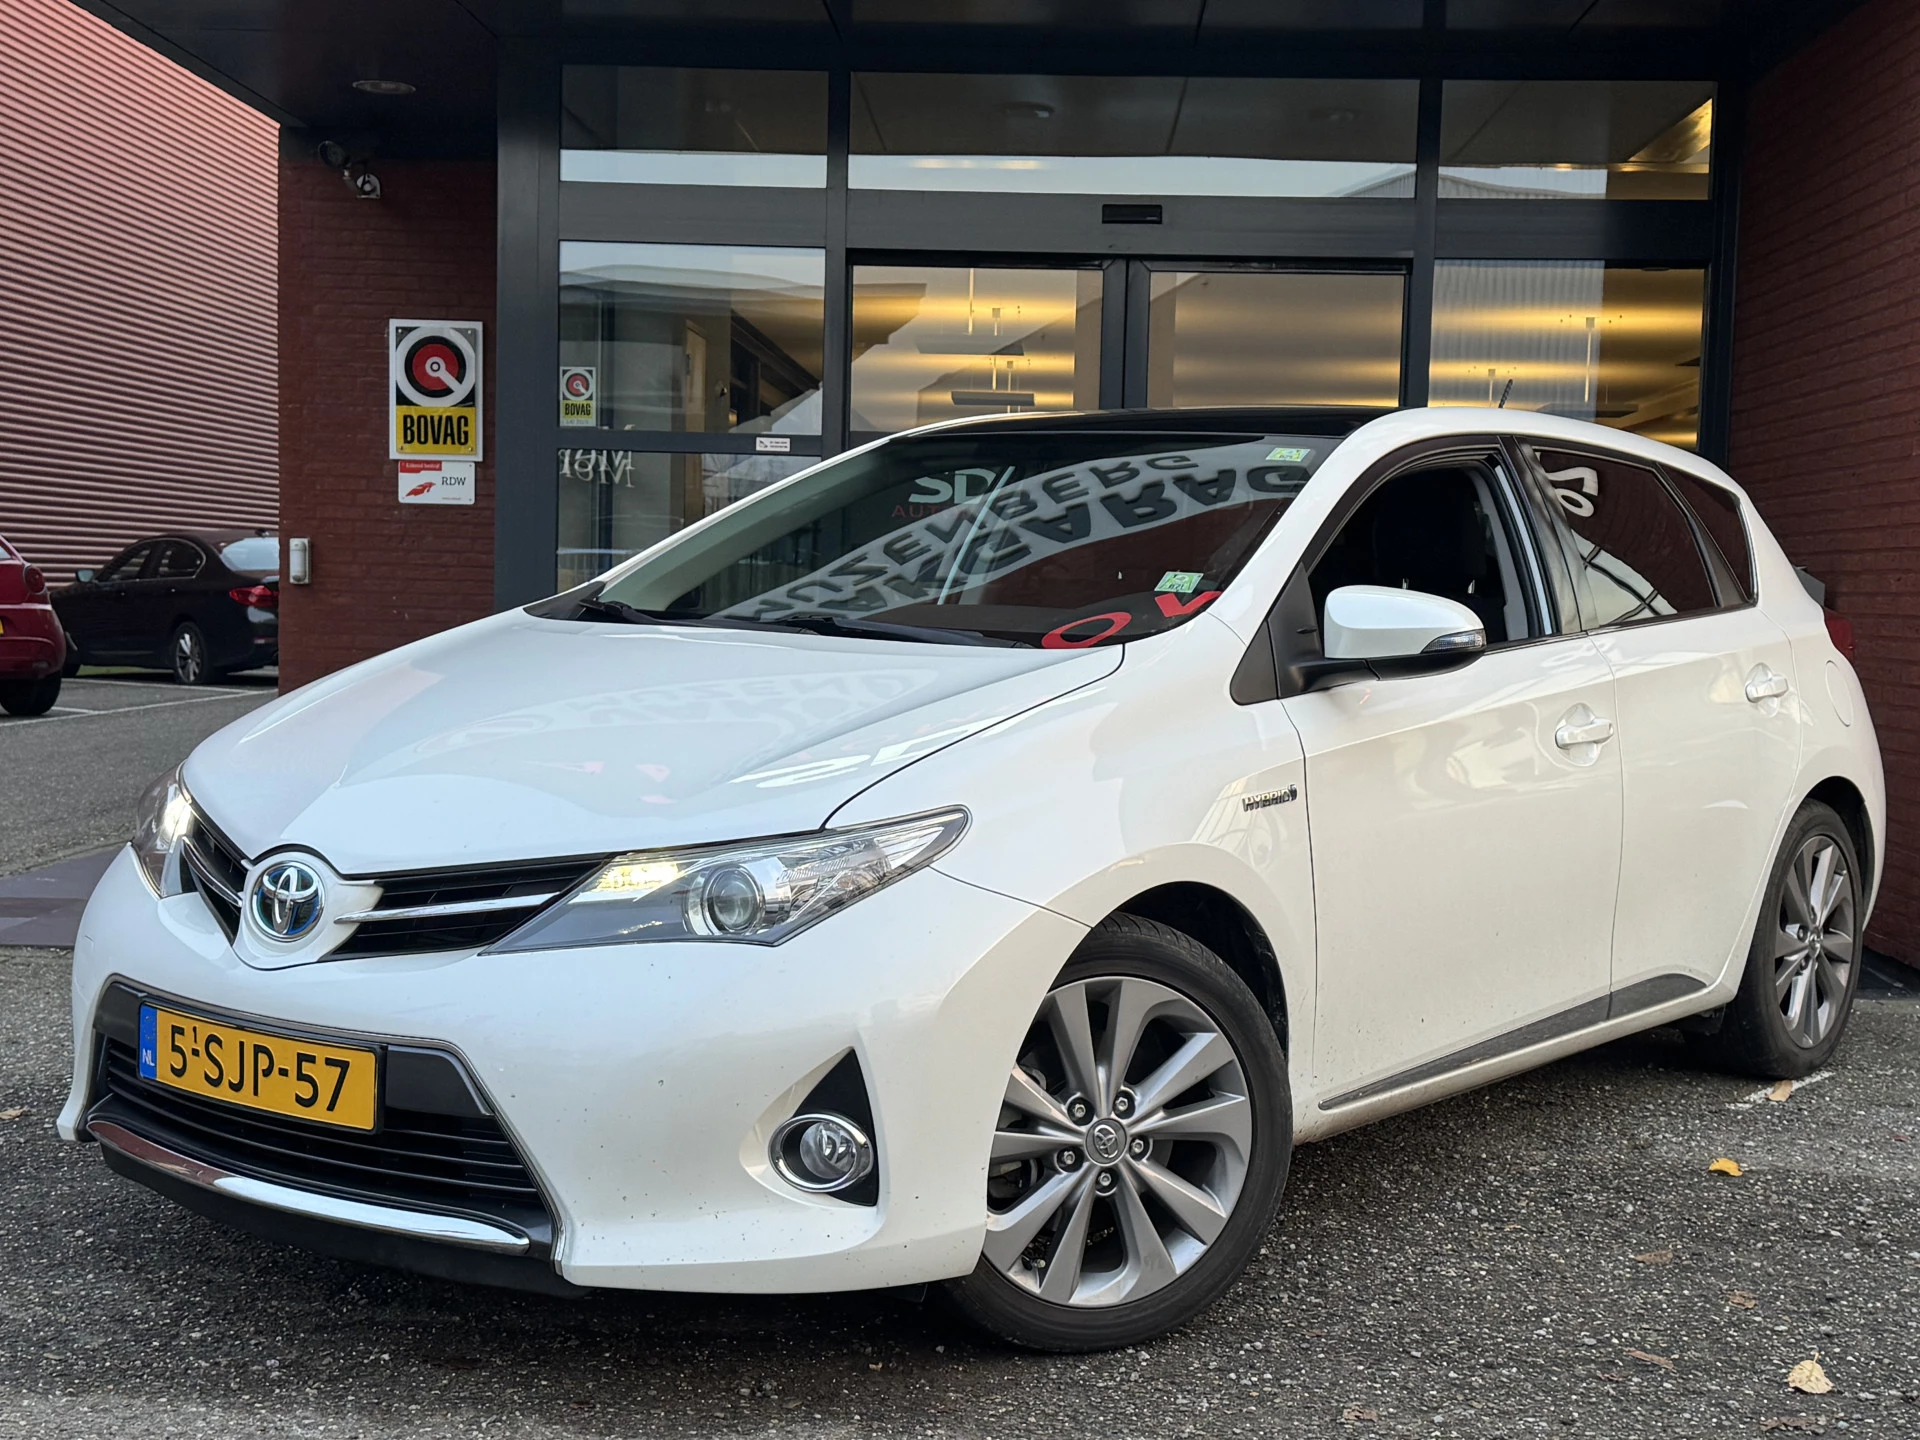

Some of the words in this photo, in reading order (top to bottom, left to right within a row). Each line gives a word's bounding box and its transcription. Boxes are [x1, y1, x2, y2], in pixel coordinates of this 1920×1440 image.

[564, 403, 591, 416] BOVAG
[403, 414, 469, 446] BOVAG
[441, 477, 466, 486] RDW
[1242, 789, 1290, 812] HYBRID
[142, 1048, 156, 1067] NL
